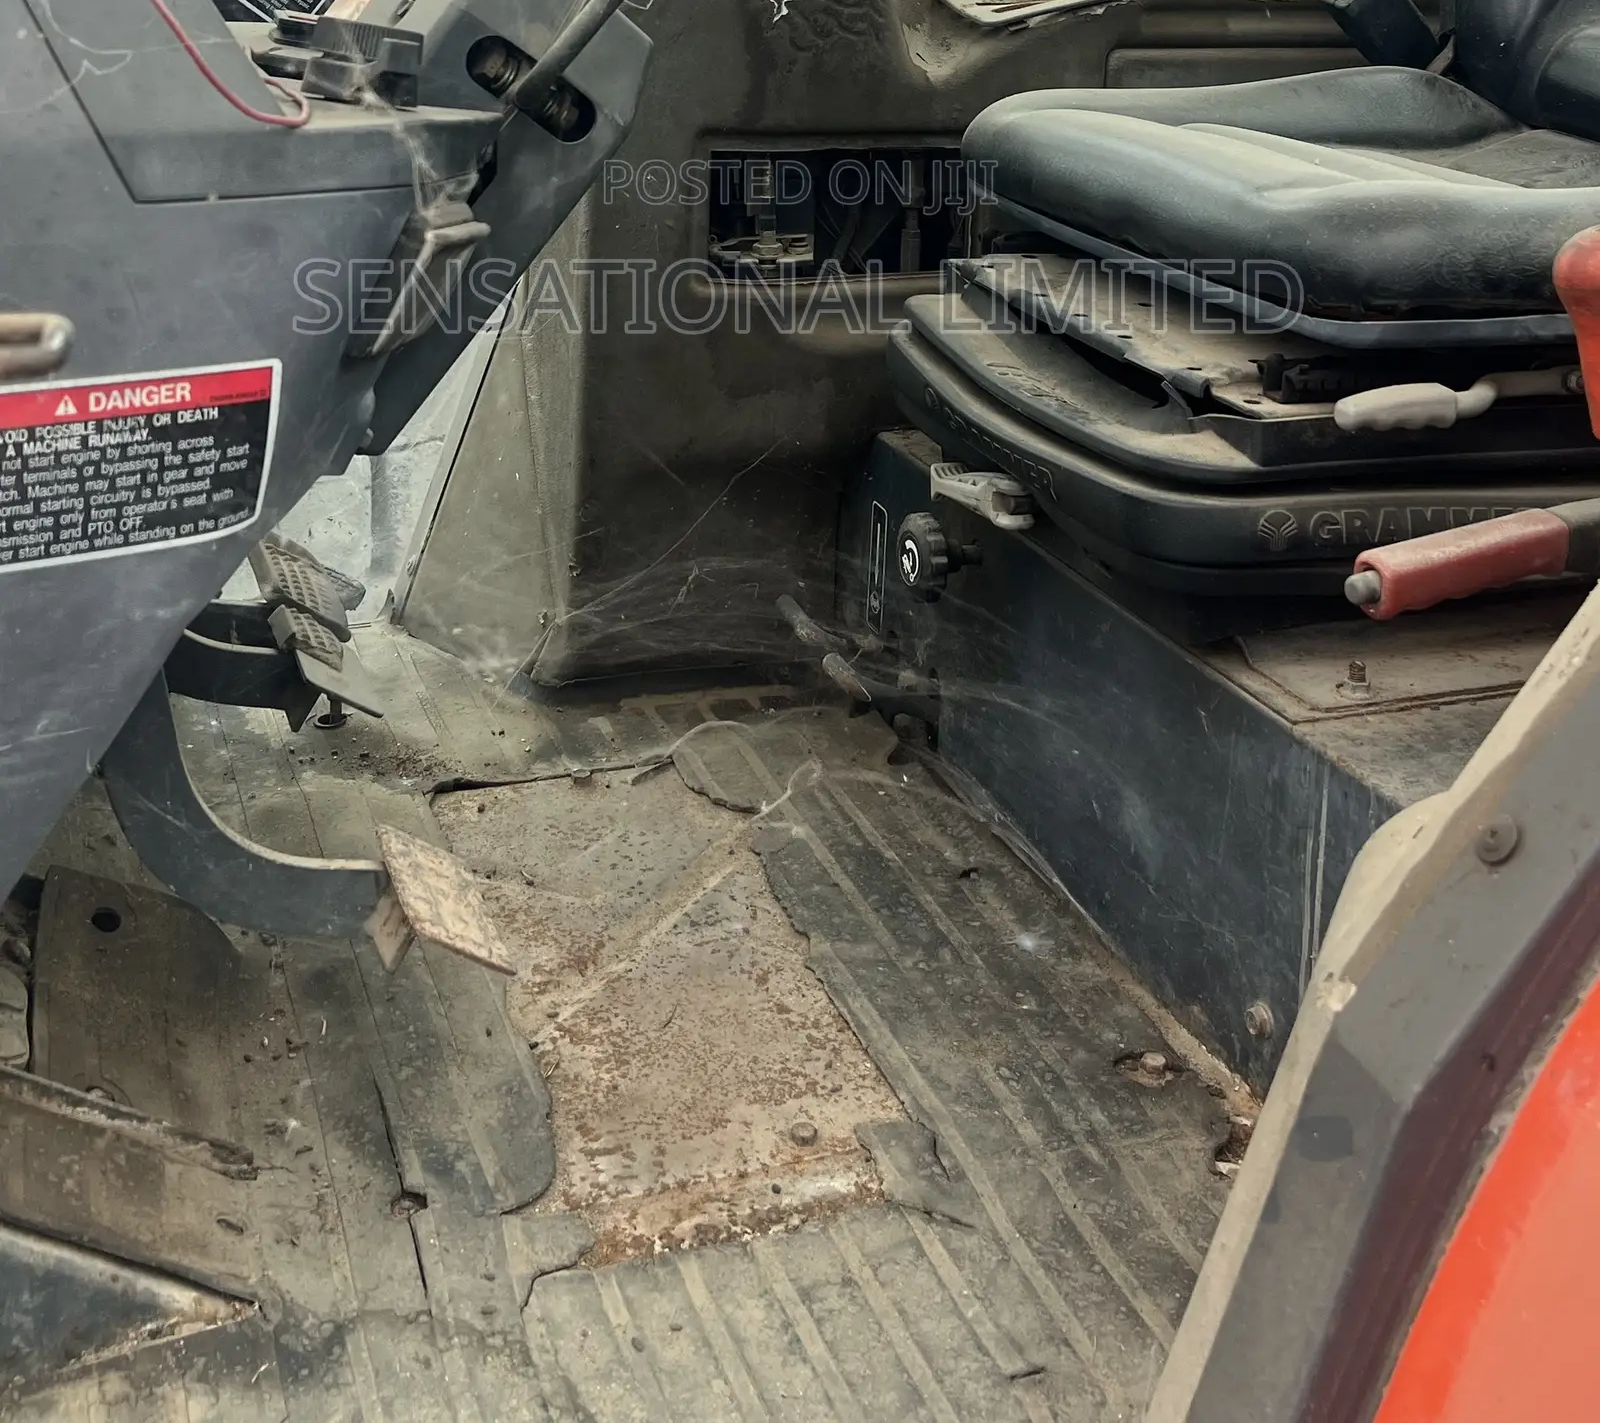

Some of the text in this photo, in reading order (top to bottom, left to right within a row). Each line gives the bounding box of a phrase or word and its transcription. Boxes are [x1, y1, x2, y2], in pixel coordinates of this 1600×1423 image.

[88, 381, 192, 413] DANGER
[0, 406, 219, 445] OID POSSIBLE INJURY OR DEATH
[6, 428, 152, 458] A MACHINE RUNAWAY.
[0, 442, 250, 487] ter terminals or bypassing the safety start
[1, 435, 215, 471] not start engine by shorting across
[0, 458, 248, 502] tch. Machine may start in gear and move
[0, 500, 34, 518] ormal
[40, 497, 85, 514] starting
[89, 489, 137, 507] circuitry
[141, 485, 153, 499] is
[13, 515, 55, 531] engine
[59, 510, 85, 526] only
[90, 507, 117, 521] from
[182, 492, 208, 508] seat
[211, 487, 234, 503] with
[0, 530, 54, 548] smission
[59, 526, 82, 540] and
[87, 520, 115, 537] PTO
[19, 543, 46, 559] start
[49, 538, 90, 555] engine
[93, 532, 125, 548] while
[128, 524, 176, 543] standing
[180, 522, 194, 535] on
[198, 517, 215, 532] the
[1308, 507, 1535, 546] GRAM
